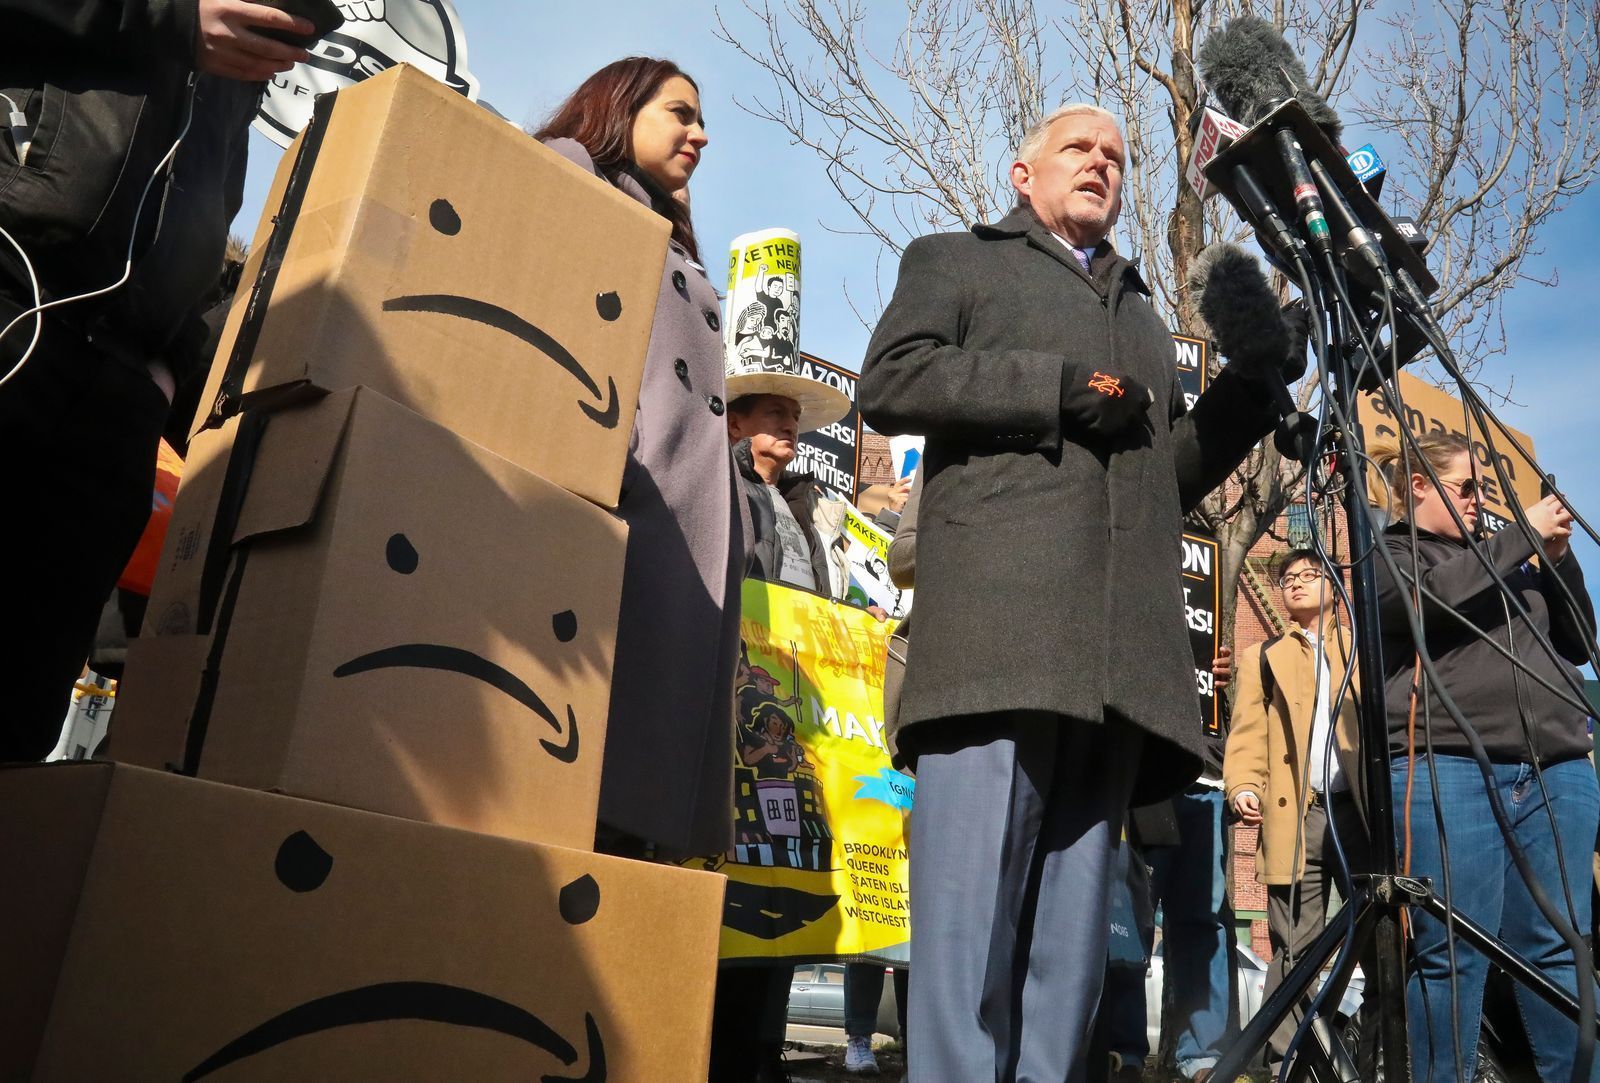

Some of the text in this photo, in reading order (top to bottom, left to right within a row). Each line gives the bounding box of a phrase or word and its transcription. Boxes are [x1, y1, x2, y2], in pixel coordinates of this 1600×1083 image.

[763, 243, 795, 258] THE
[845, 513, 877, 543] MAKE
[844, 843, 909, 860] BROOKLYN
[847, 858, 889, 876] QUEENS
[850, 873, 887, 891] STATEN
[853, 889, 879, 906] LONG
[845, 906, 910, 928] WESTCHEST
